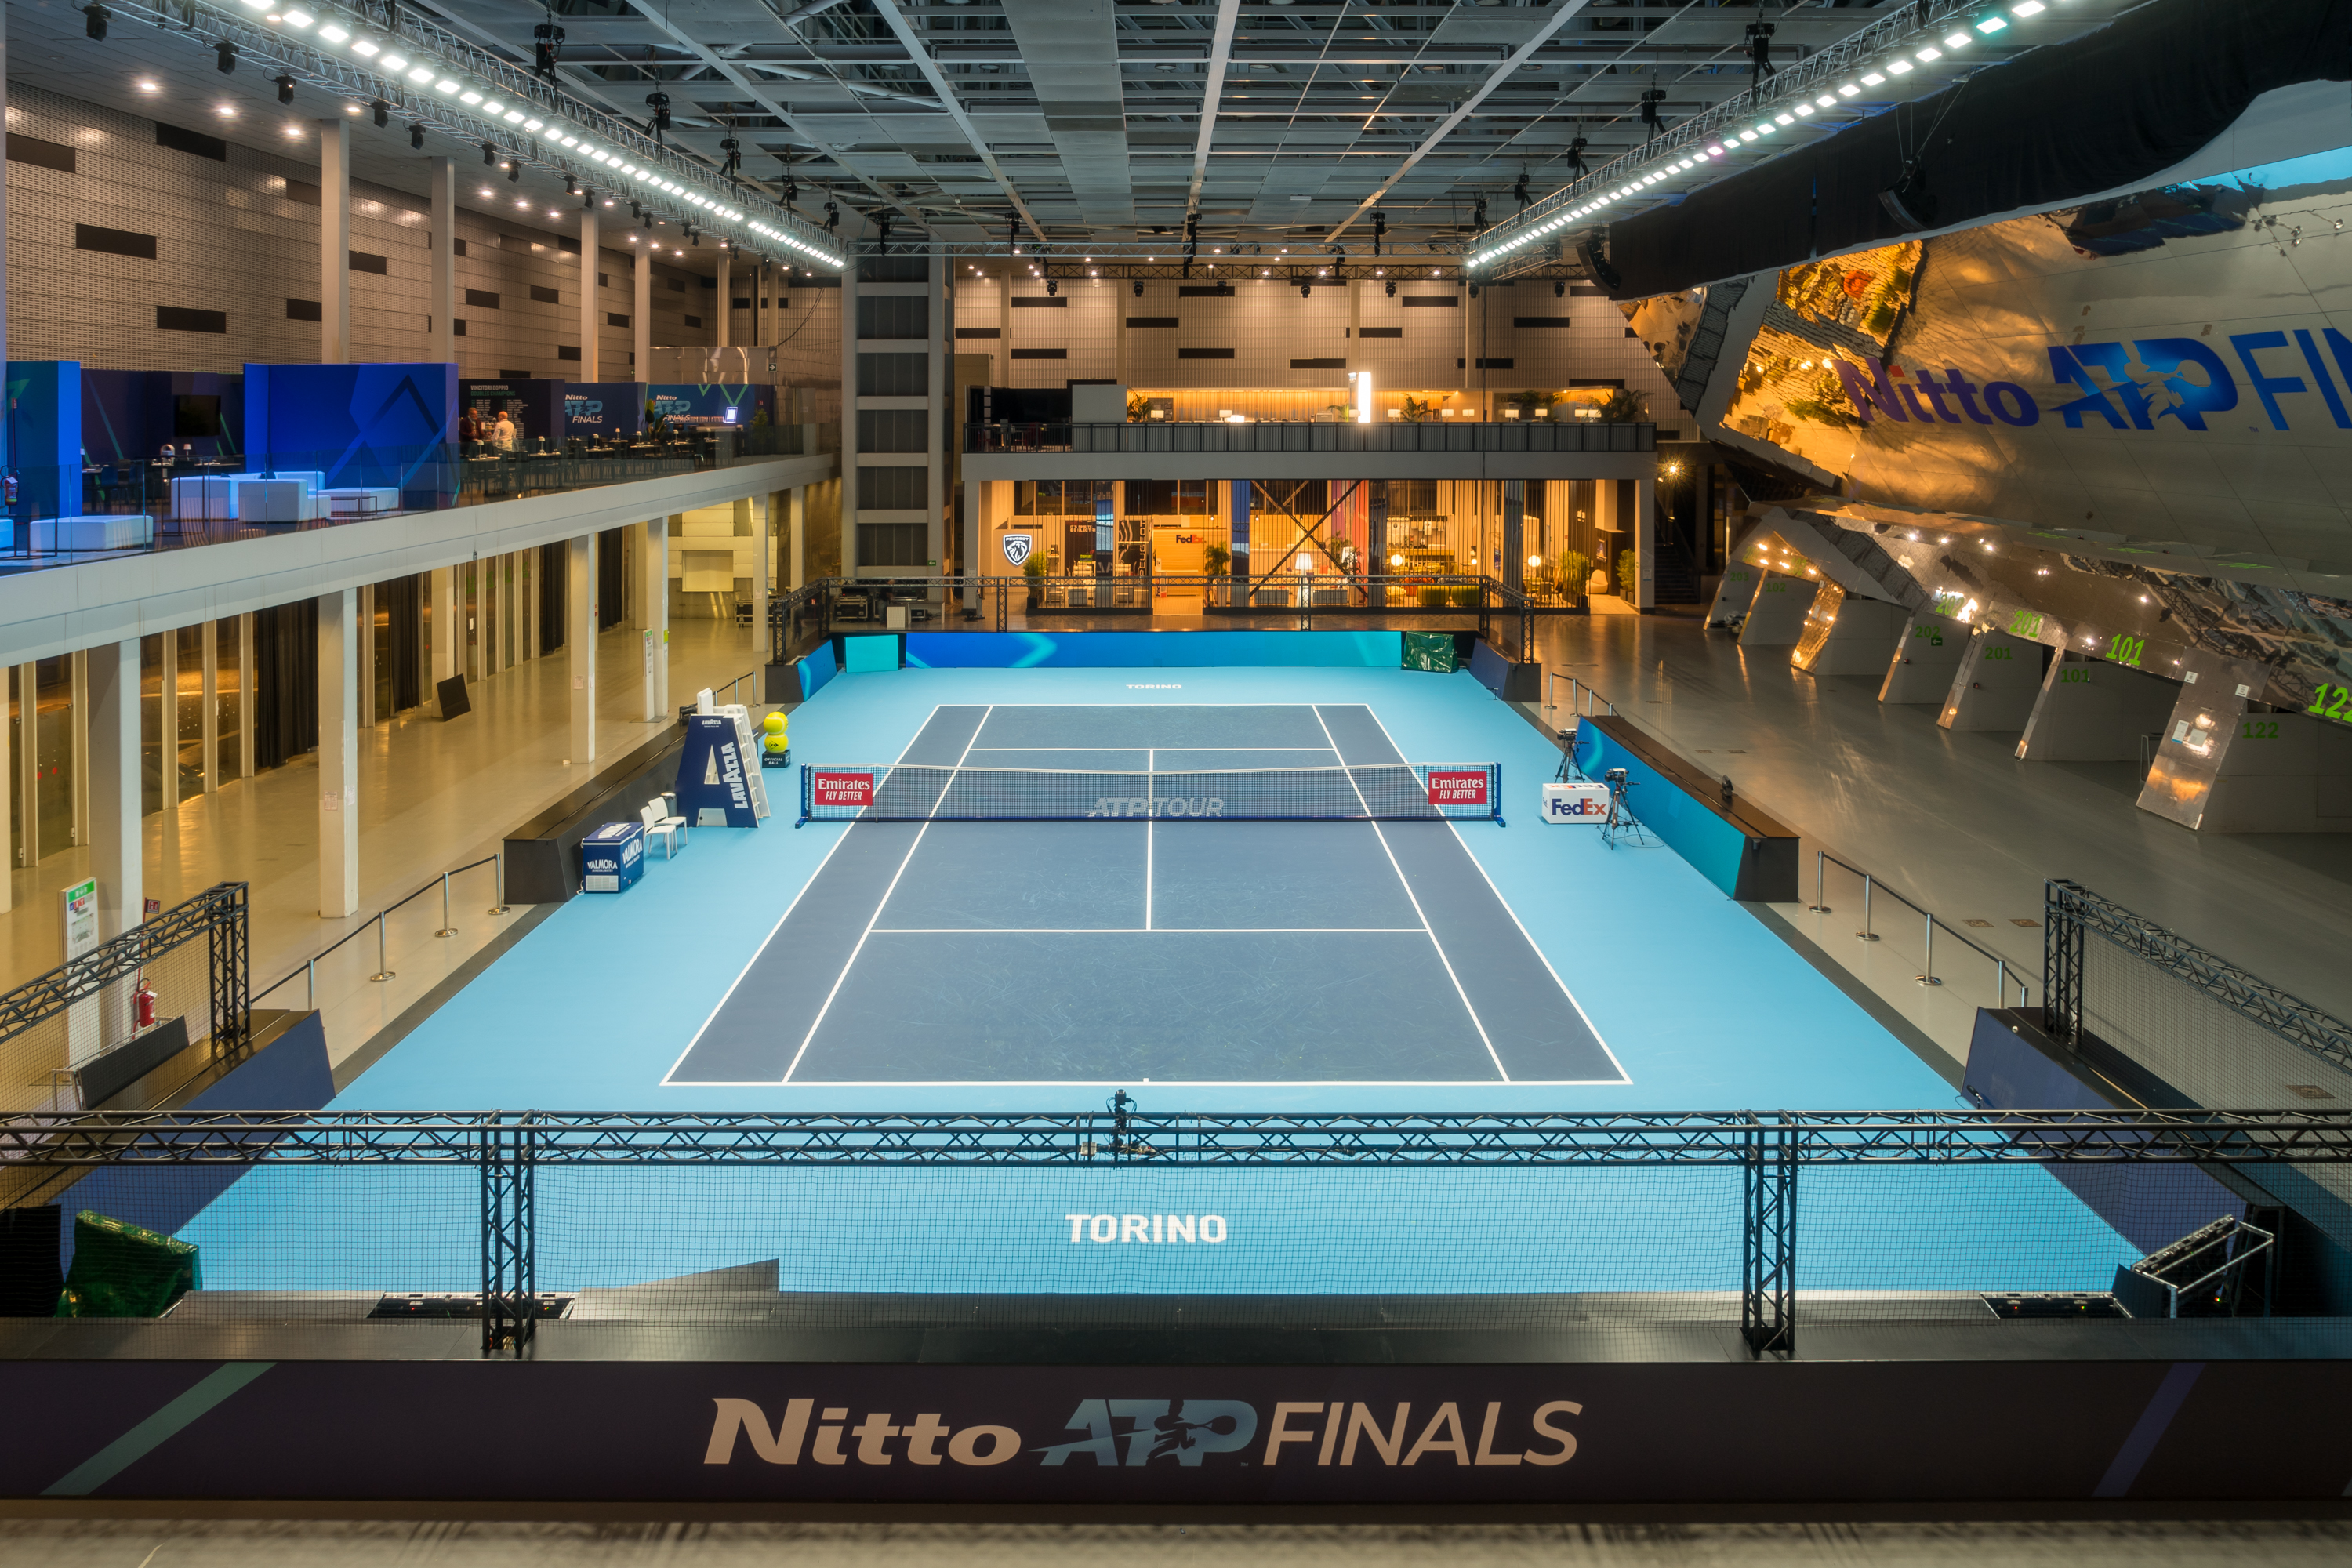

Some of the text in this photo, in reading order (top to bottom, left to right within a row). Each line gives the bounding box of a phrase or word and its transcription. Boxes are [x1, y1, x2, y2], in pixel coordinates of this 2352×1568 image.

[1832, 328, 2352, 431] Nitto ATP FI
[1176, 535, 1203, 543] FedEx
[1730, 572, 1750, 582] 203
[1766, 583, 1786, 593] 102
[2009, 610, 2042, 638] 201
[1915, 626, 1940, 638] 202
[1985, 647, 2013, 660] 201
[2106, 633, 2145, 666] 101
[2060, 669, 2089, 683] 101
[2242, 722, 2279, 739] 122
[720, 742, 749, 808] LAVAZZA
[818, 779, 871, 790] Emirates
[1432, 777, 1484, 789] Emirates
[826, 791, 862, 800] FLY BETTER
[1439, 789, 1476, 799] FLY BETTER
[1086, 797, 1224, 817] ATP TOUR
[1552, 798, 1606, 815] FedEx
[622, 839, 643, 865] VALMORA
[587, 859, 618, 869] VALMORA
[1065, 1214, 1228, 1243] TORINO
[703, 1398, 1584, 1467] Nitto ATP FINALS
